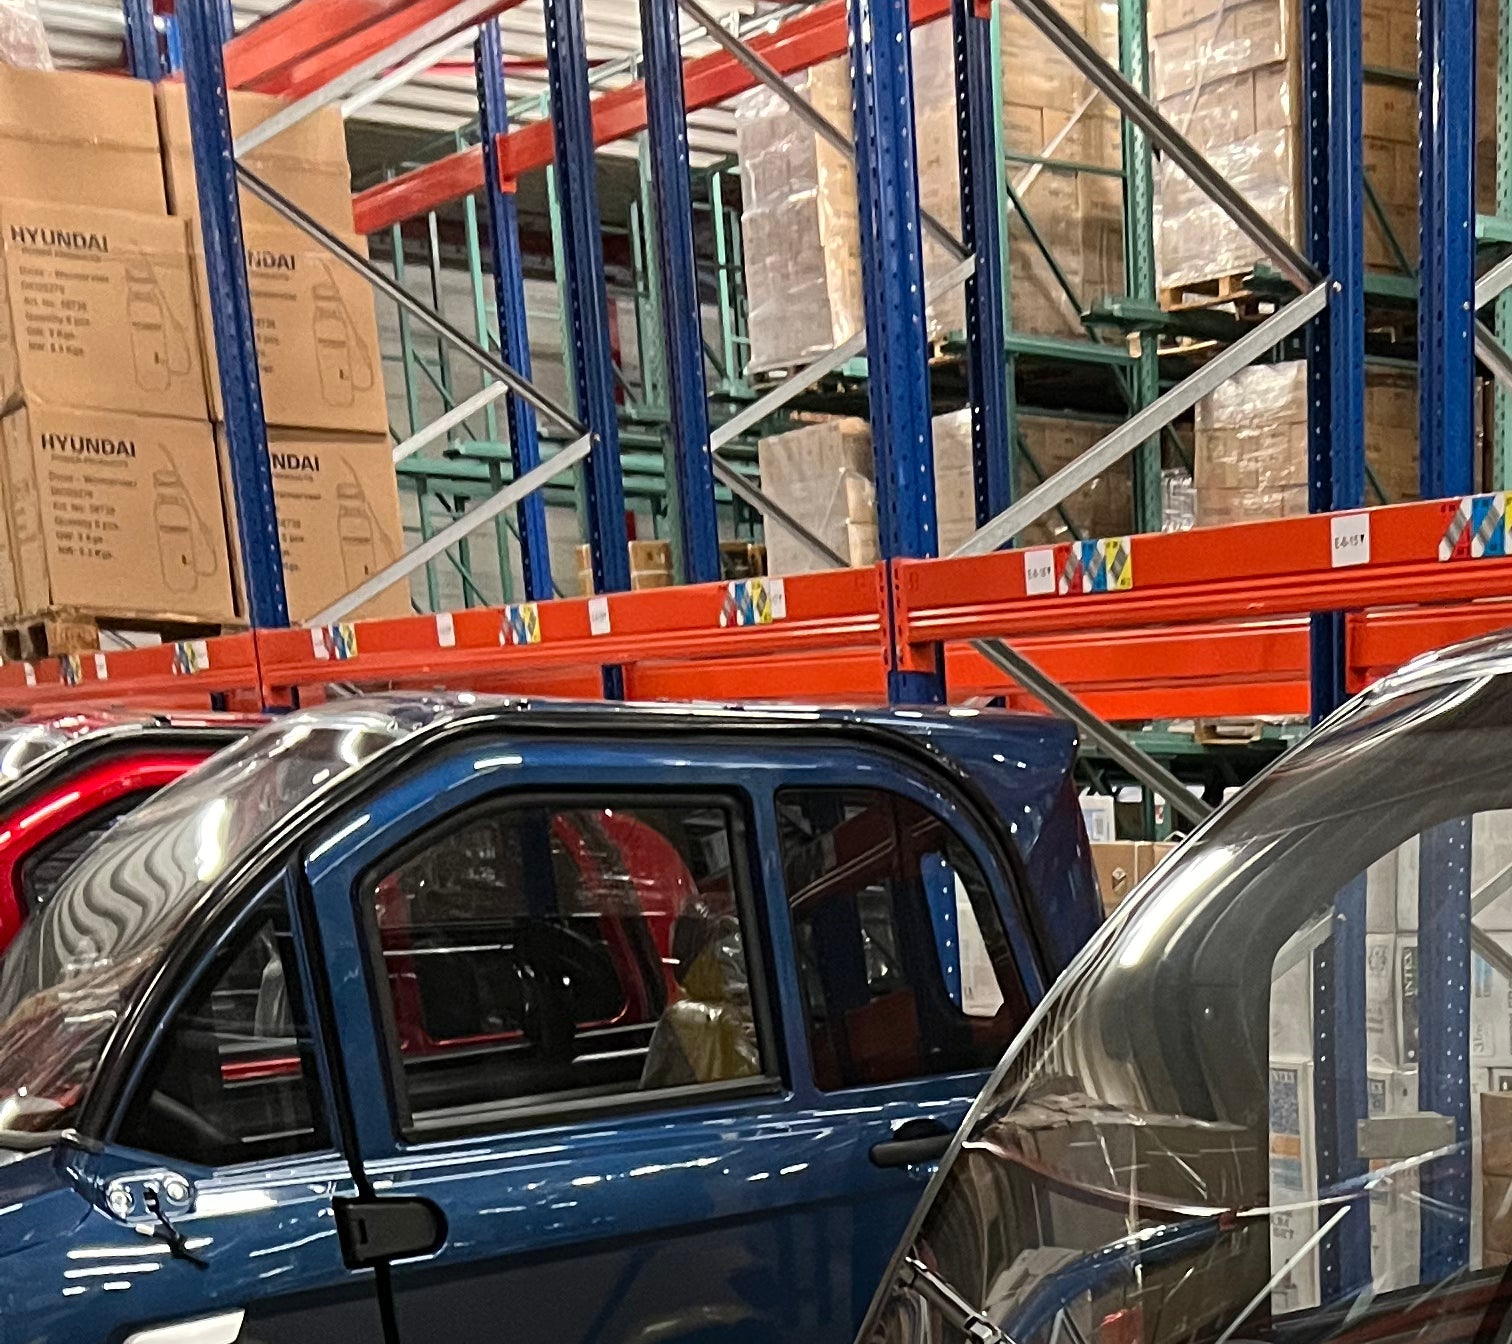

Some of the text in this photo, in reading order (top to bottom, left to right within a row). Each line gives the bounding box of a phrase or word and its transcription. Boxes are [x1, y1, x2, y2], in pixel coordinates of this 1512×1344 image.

[10, 224, 109, 254] HYUNDAI
[249, 250, 296, 270] NDAI
[41, 432, 136, 458] HYUNDAI
[271, 453, 320, 472] NDAI
